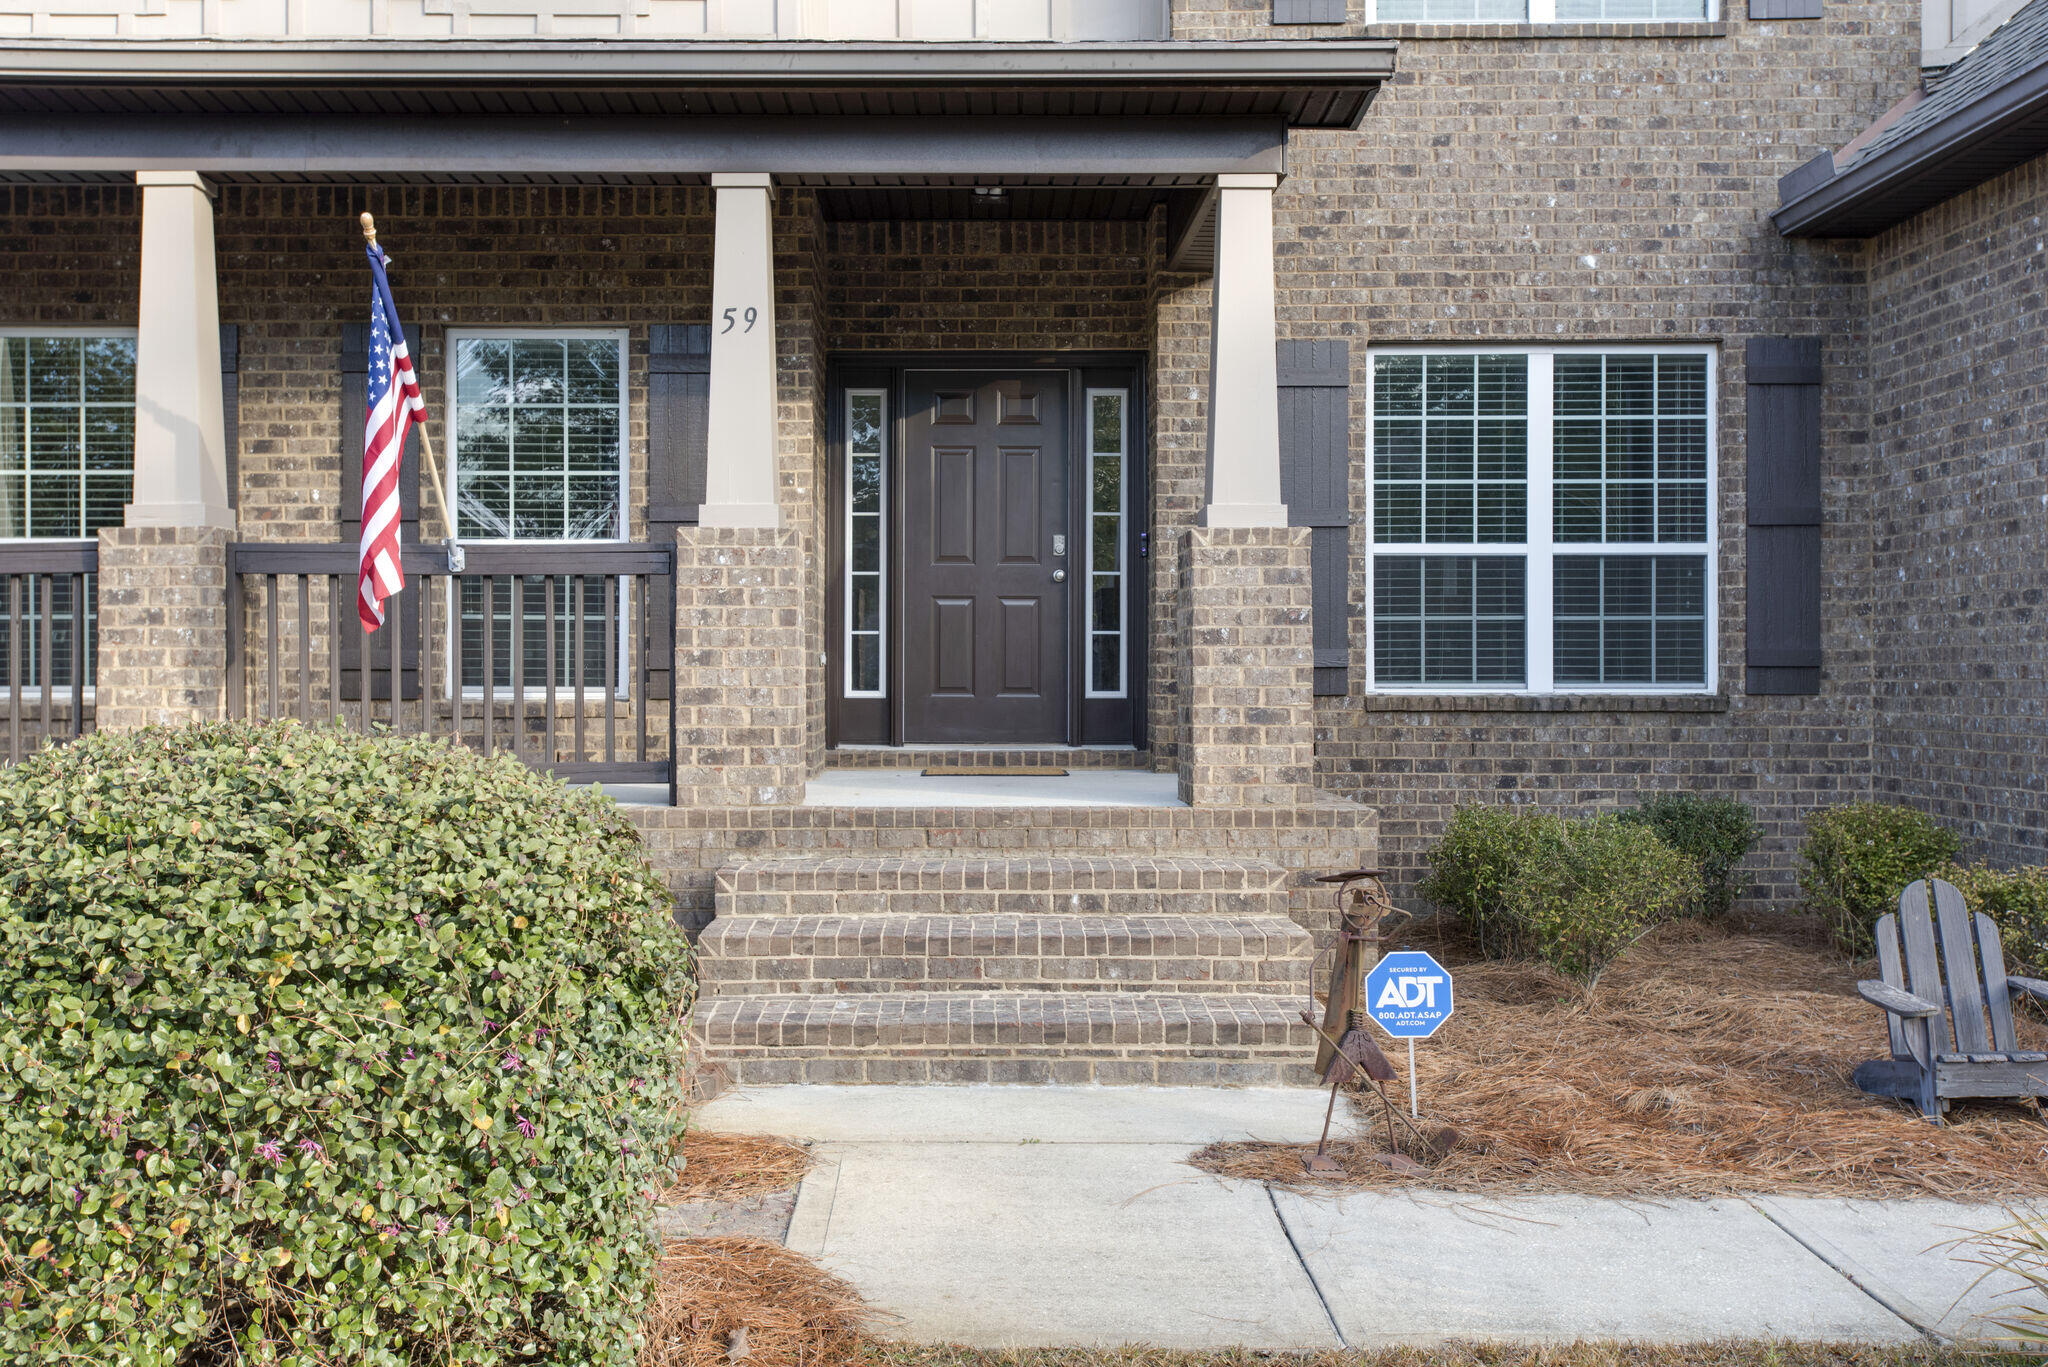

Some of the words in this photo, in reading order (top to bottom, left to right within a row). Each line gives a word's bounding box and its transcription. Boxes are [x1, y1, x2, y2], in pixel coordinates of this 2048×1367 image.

[721, 307, 757, 334] 59
[1375, 976, 1443, 1008] ADT
[1379, 1011, 1442, 1019] 800.ADT.ASAP
